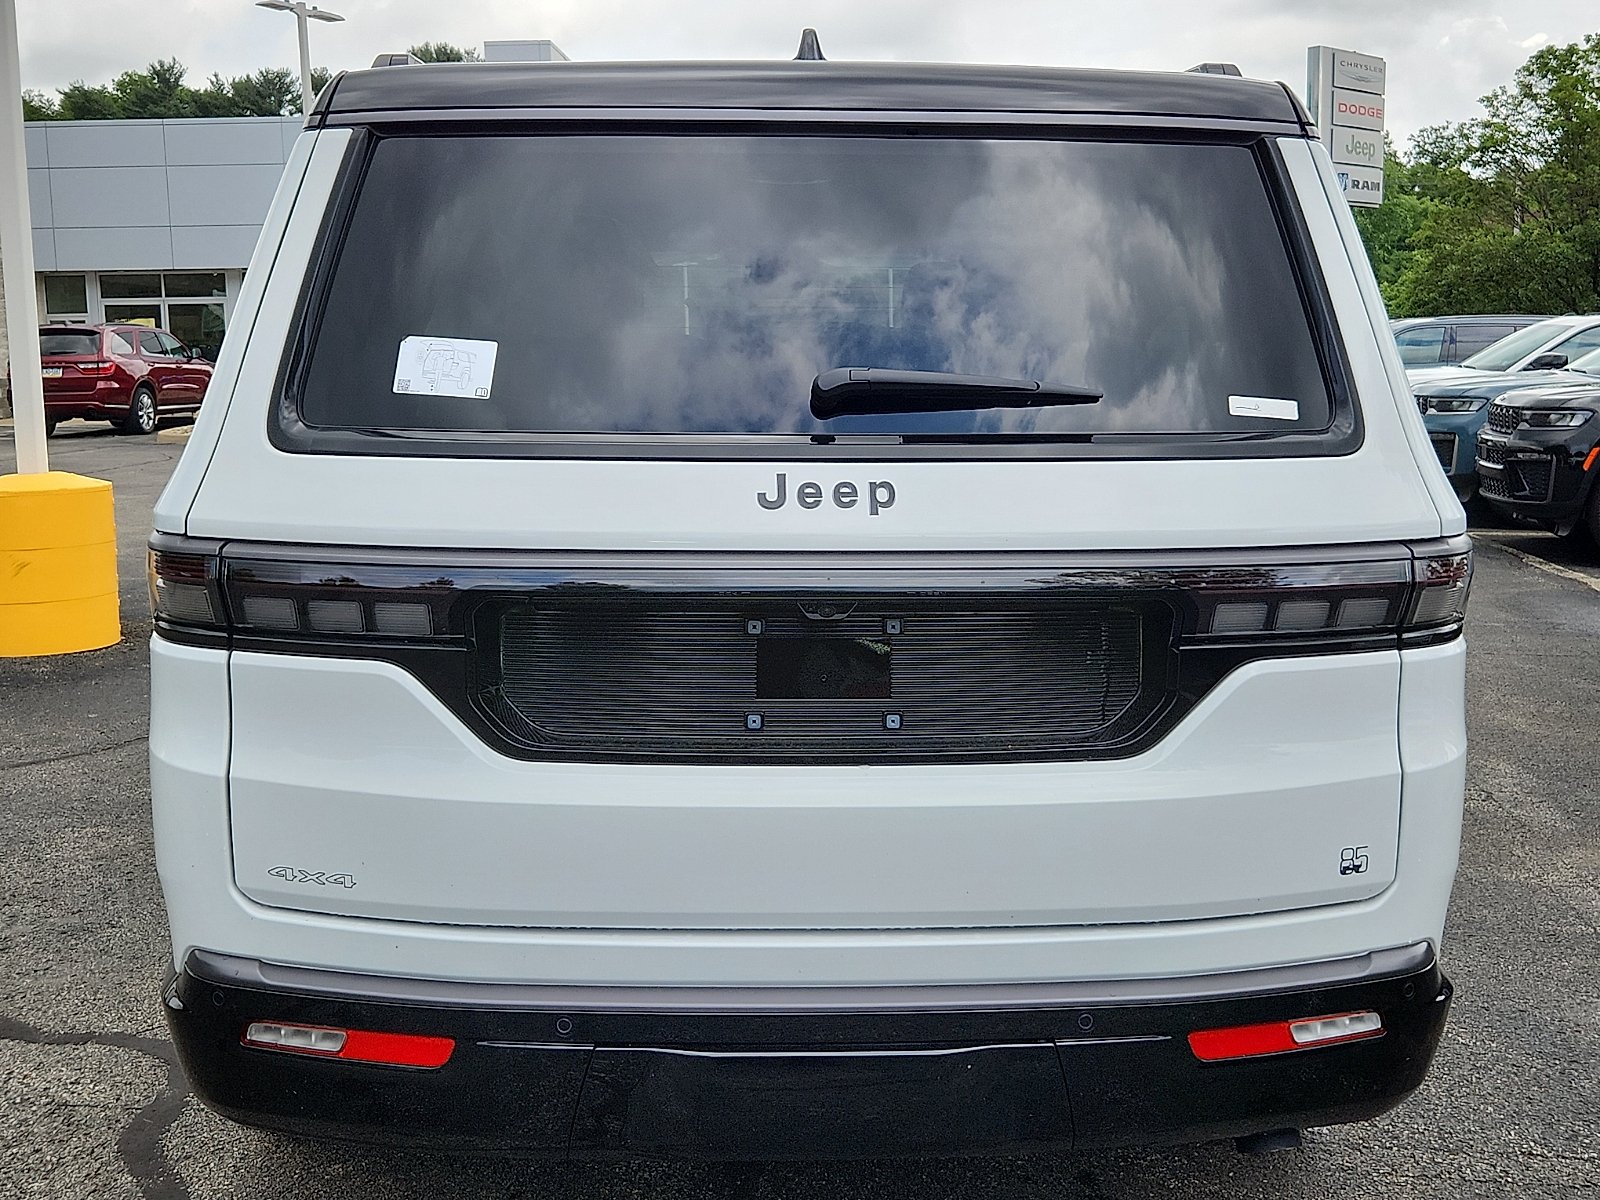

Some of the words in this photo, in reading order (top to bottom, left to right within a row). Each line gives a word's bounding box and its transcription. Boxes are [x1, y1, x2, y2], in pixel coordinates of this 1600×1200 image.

[1339, 60, 1383, 73] CHRYSLER
[1338, 103, 1382, 119] DODGE
[1345, 134, 1376, 161] Jeep
[1351, 179, 1380, 192] RAM
[757, 473, 896, 516] Jeep
